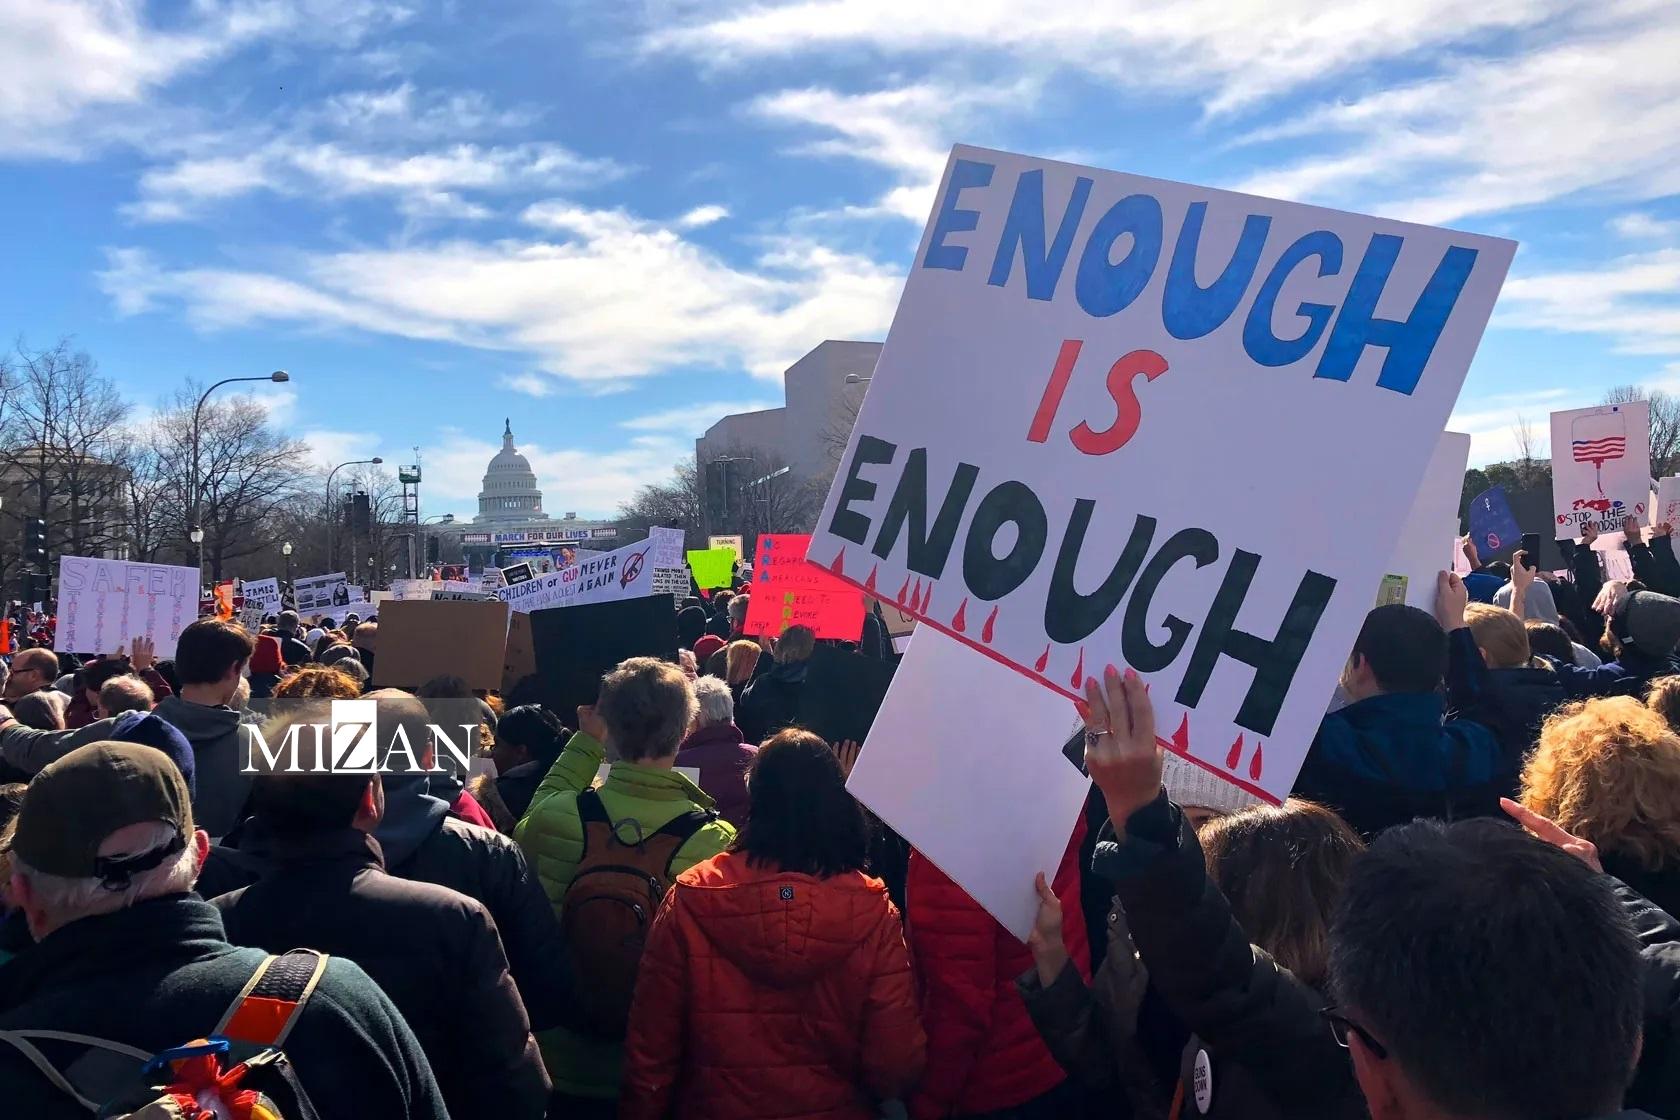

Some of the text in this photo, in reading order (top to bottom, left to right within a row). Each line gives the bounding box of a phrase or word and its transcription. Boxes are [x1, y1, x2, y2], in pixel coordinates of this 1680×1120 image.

[922, 159, 1479, 396] ENOUGH
[1026, 339, 1170, 456] IS
[1565, 506, 1626, 526] STOP THE
[494, 530, 588, 542] MARCH FOR OUR LIVES
[63, 558, 186, 597] SAFER
[580, 555, 617, 577] NEVER
[245, 585, 274, 597] JAMES
[499, 579, 543, 601] CHILDREN
[547, 578, 558, 588] or
[578, 571, 615, 594] AGAIN
[828, 434, 1338, 737] ENOUGH
